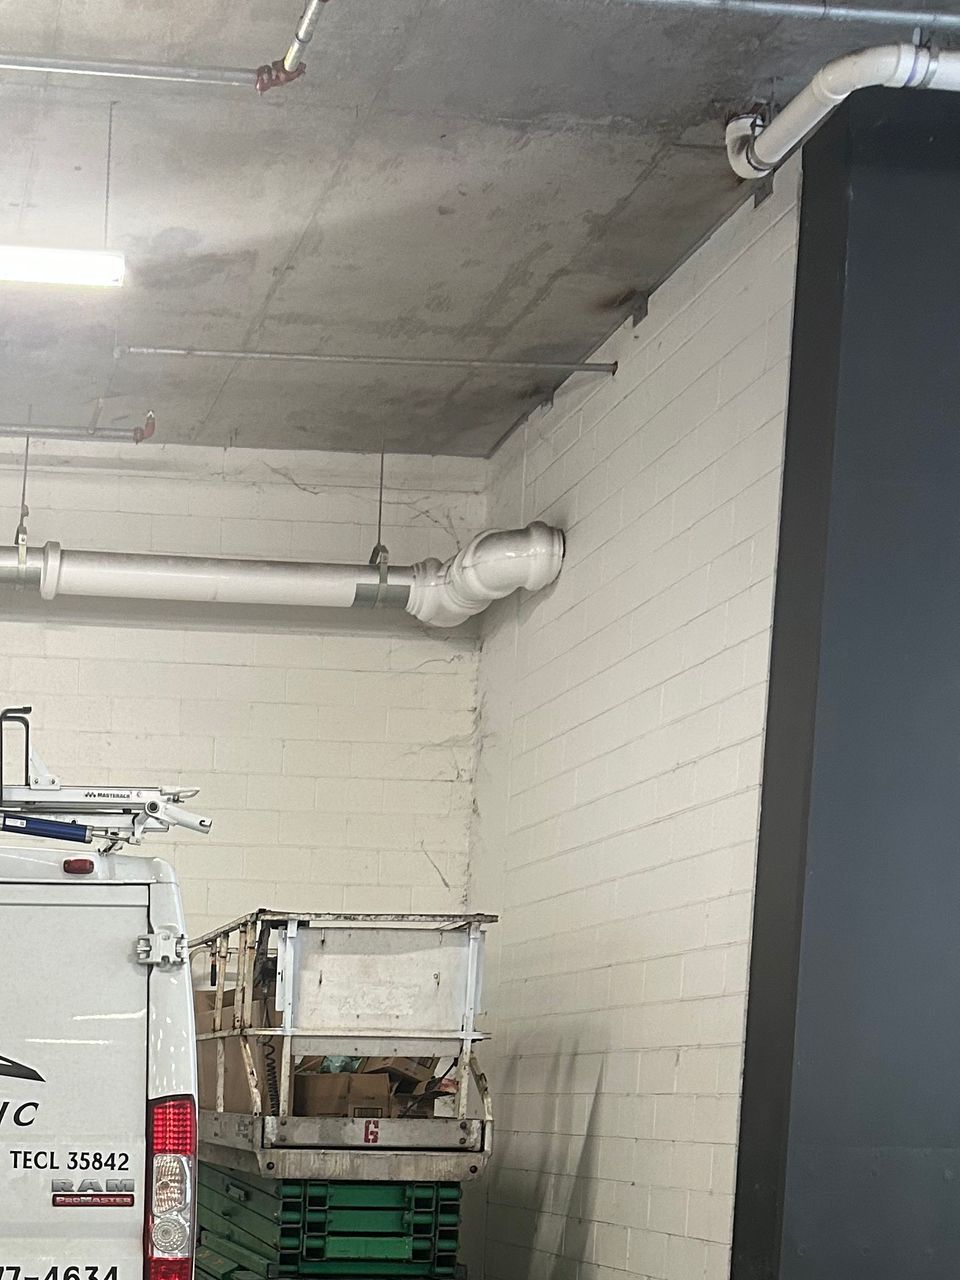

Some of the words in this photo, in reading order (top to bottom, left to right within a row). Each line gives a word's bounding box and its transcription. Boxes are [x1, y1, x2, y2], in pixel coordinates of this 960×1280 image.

[9, 1150, 60, 1170] TECL
[66, 1151, 130, 1171] 35842
[51, 1178, 135, 1193] RAM
